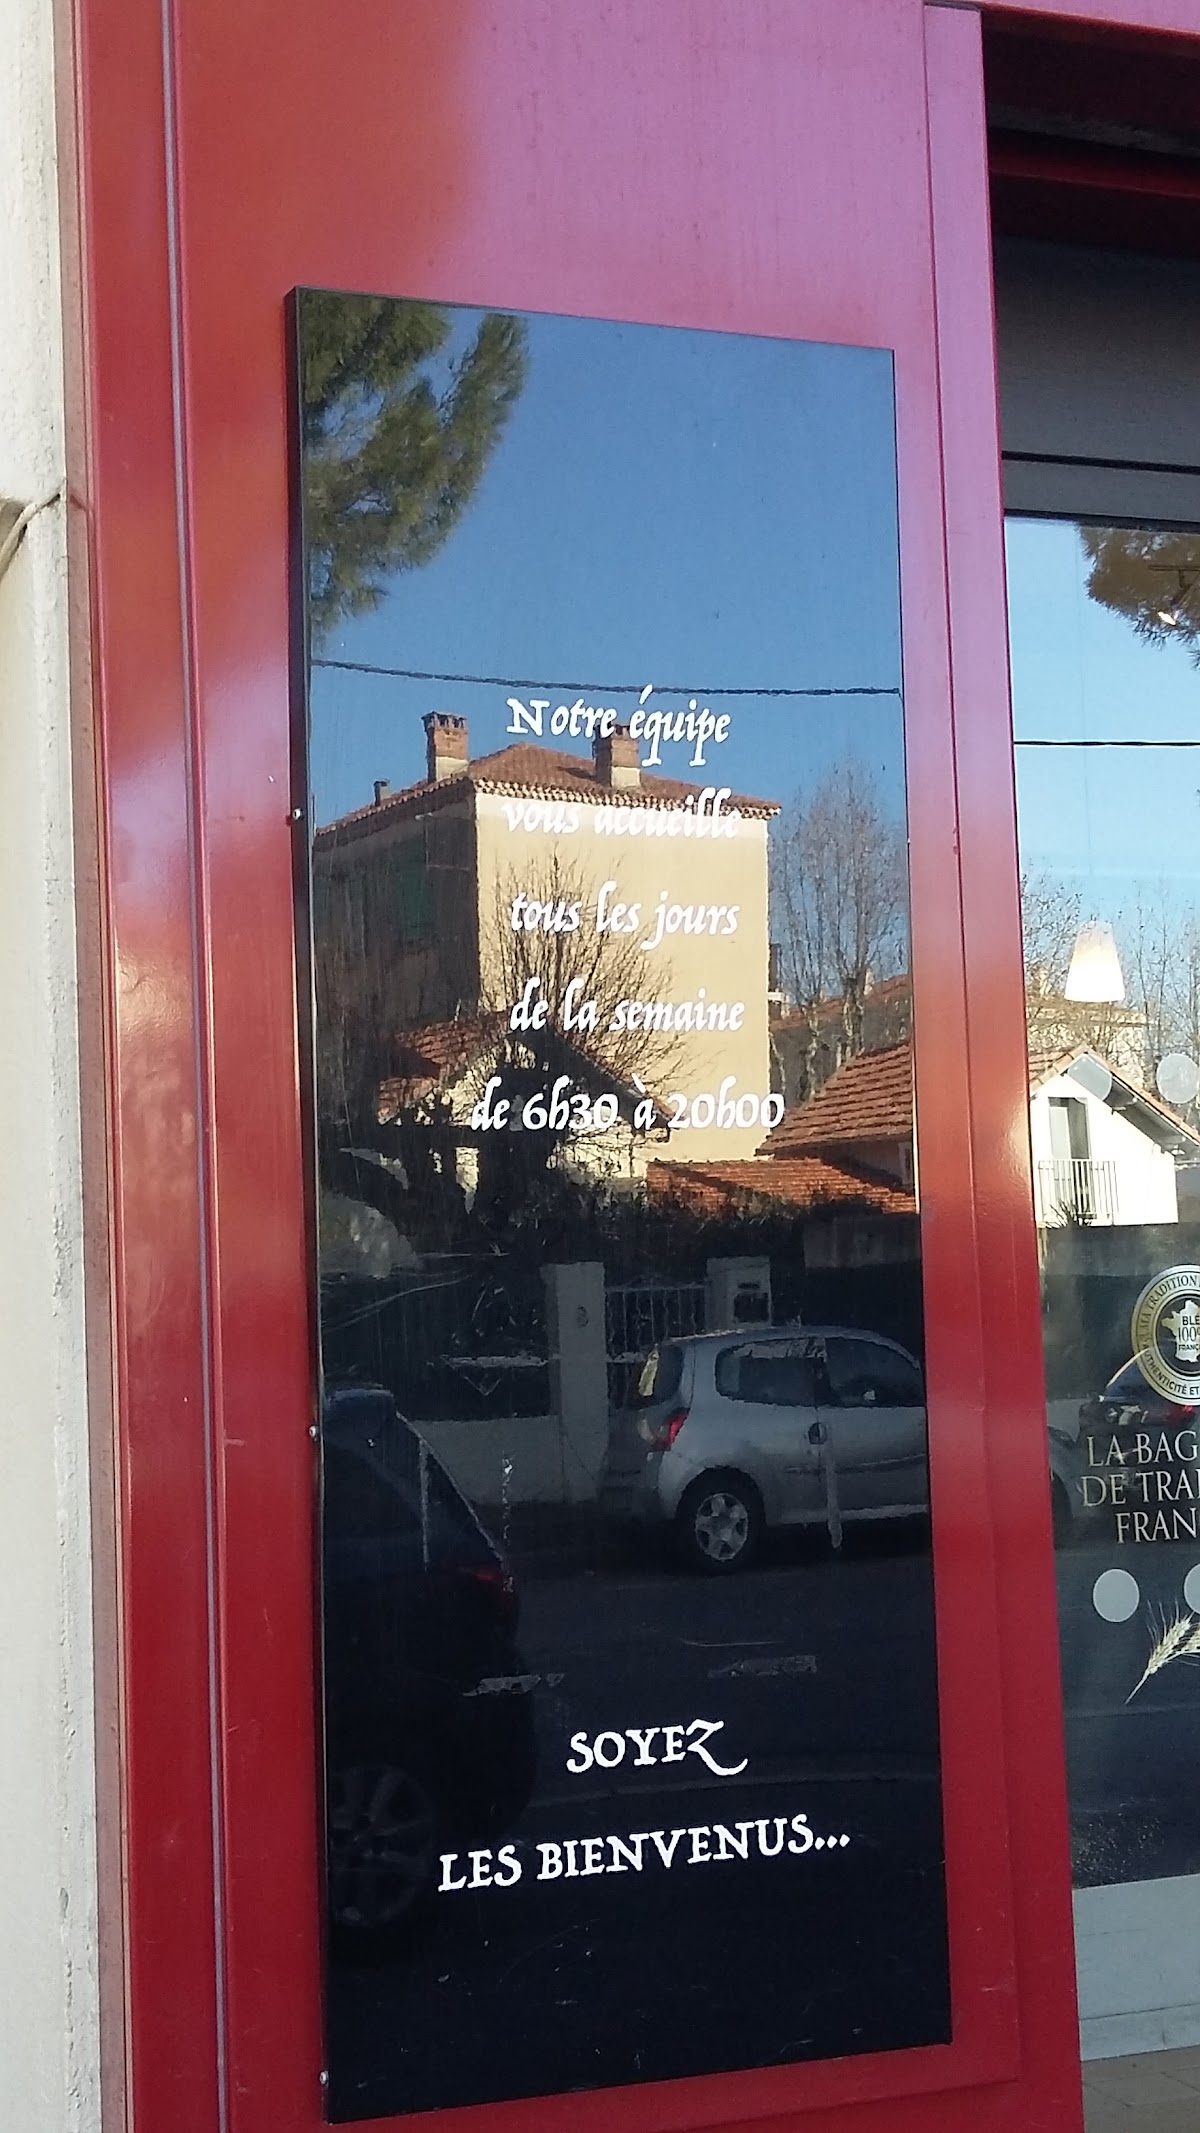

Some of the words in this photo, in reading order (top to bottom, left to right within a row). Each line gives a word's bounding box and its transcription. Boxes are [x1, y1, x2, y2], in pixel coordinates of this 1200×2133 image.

[506, 697, 616, 737] Notre
[629, 684, 732, 768] équipe
[502, 802, 580, 834] vous
[593, 787, 742, 839] accueille
[510, 892, 581, 934] tous
[595, 880, 642, 934] les
[640, 891, 740, 951] jours
[509, 977, 547, 1033] de
[562, 977, 601, 1033] la
[608, 991, 745, 1032] semaine
[470, 1076, 509, 1131] de
[521, 1076, 619, 1131] 6h30
[633, 1075, 657, 1130] à
[668, 1076, 785, 1130] 20h00
[1086, 1434, 1126, 1467] LA
[1080, 1473, 1126, 1507] DE
[1115, 1507, 1198, 1544] FRAN
[566, 1718, 748, 1776] SOYEZ
[438, 1845, 522, 1892] LES
[537, 1814, 850, 1881] BIENVENUS...
